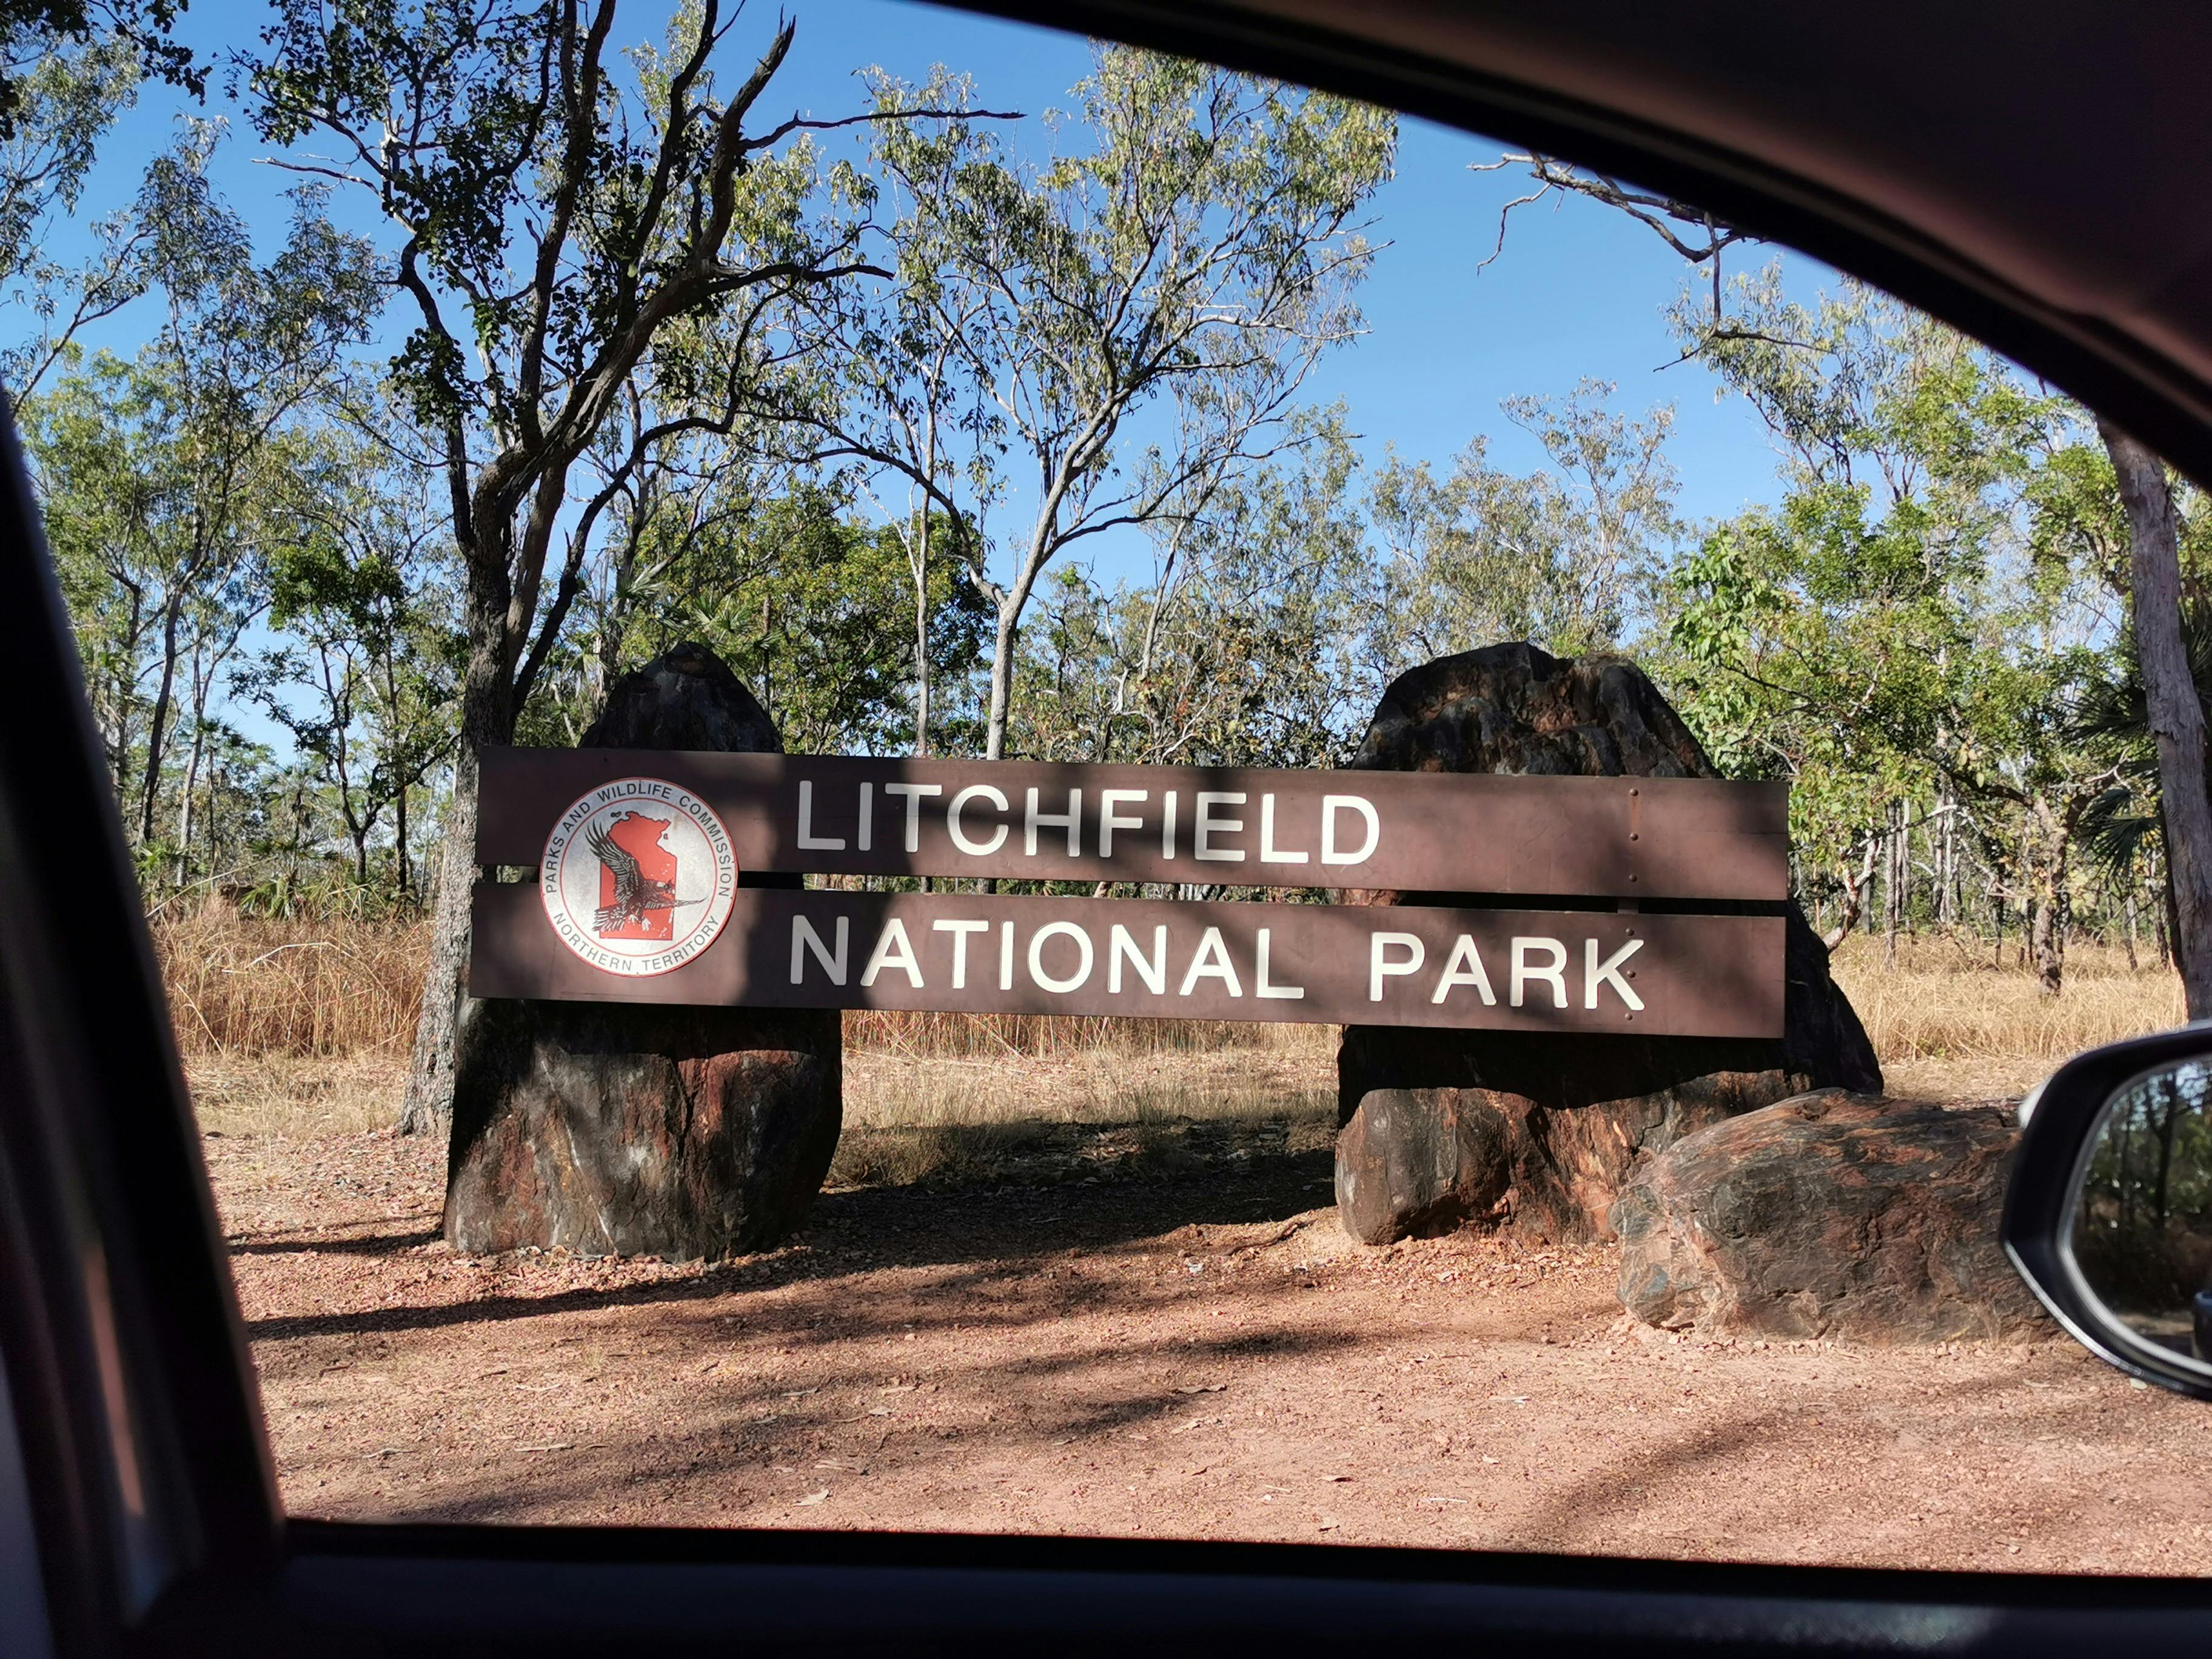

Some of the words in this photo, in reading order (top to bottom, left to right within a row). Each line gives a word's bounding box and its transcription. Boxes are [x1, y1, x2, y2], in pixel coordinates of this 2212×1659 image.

[546, 837, 565, 894] PARKS
[564, 802, 591, 833] AND
[597, 782, 672, 802] WILDLIFE
[679, 796, 732, 897] COMMISSION
[797, 780, 1381, 866] LITCHFIELD
[554, 913, 632, 971] NORTHERN
[642, 916, 720, 971] TERRITORY
[790, 914, 1304, 999] NATIONAL
[1369, 931, 1645, 1011] PARK
